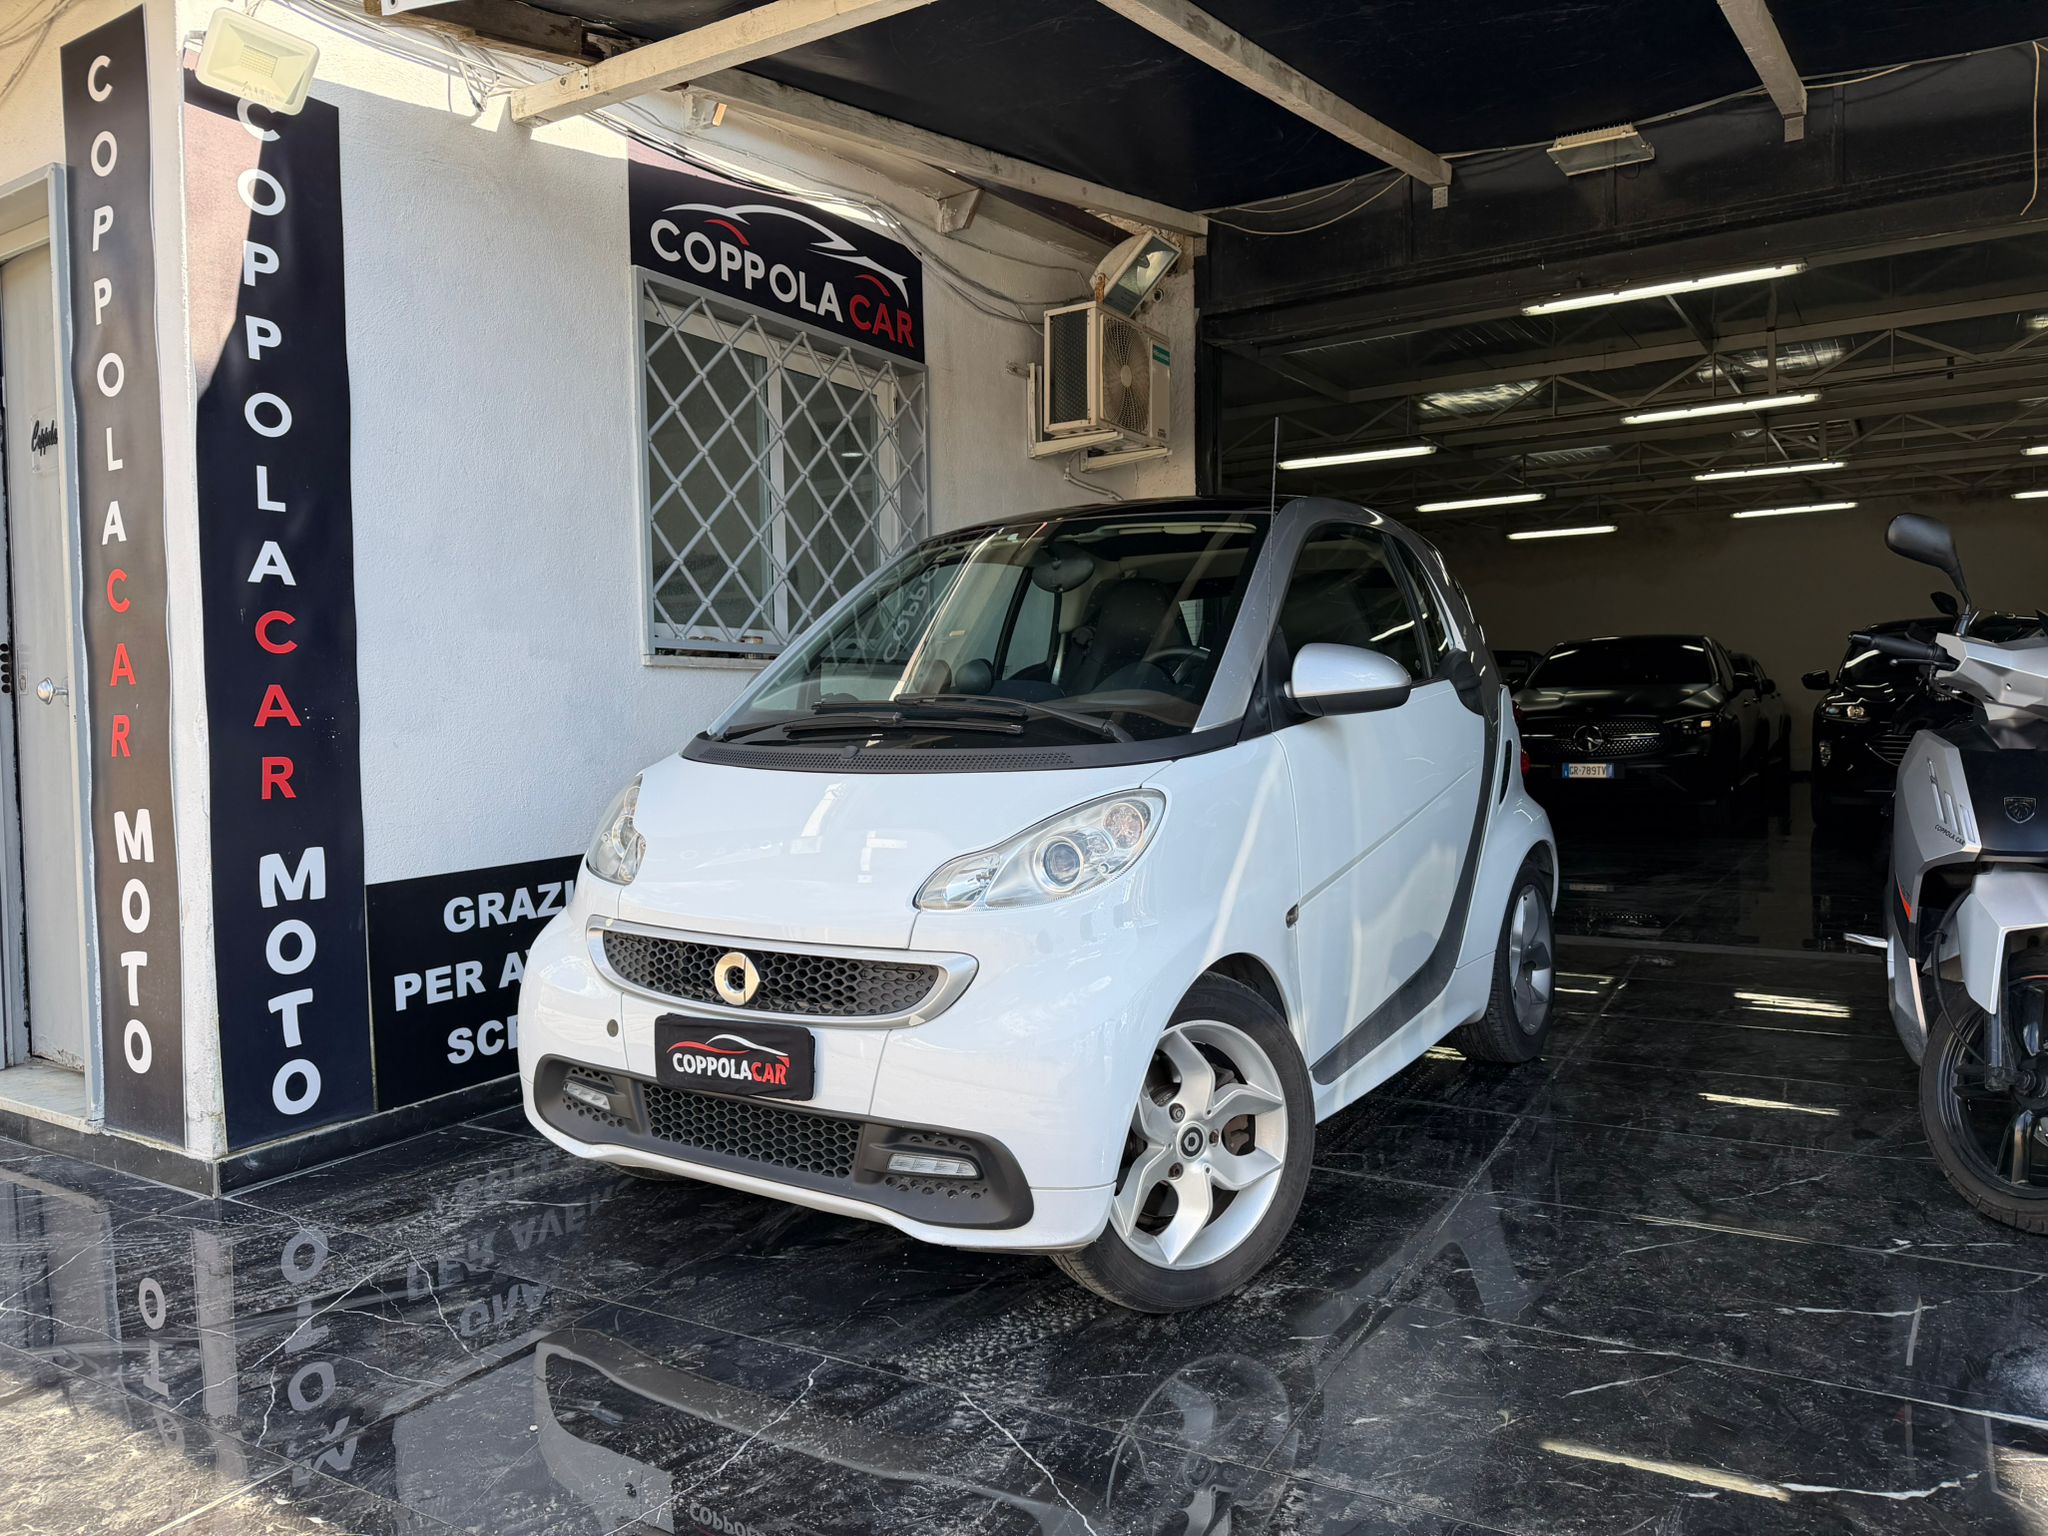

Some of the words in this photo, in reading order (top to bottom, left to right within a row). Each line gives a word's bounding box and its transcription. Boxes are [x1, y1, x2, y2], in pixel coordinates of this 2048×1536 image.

[114, 808, 155, 1074] MOTO
[258, 846, 327, 1115] MOTO
[394, 960, 486, 1012] PER
